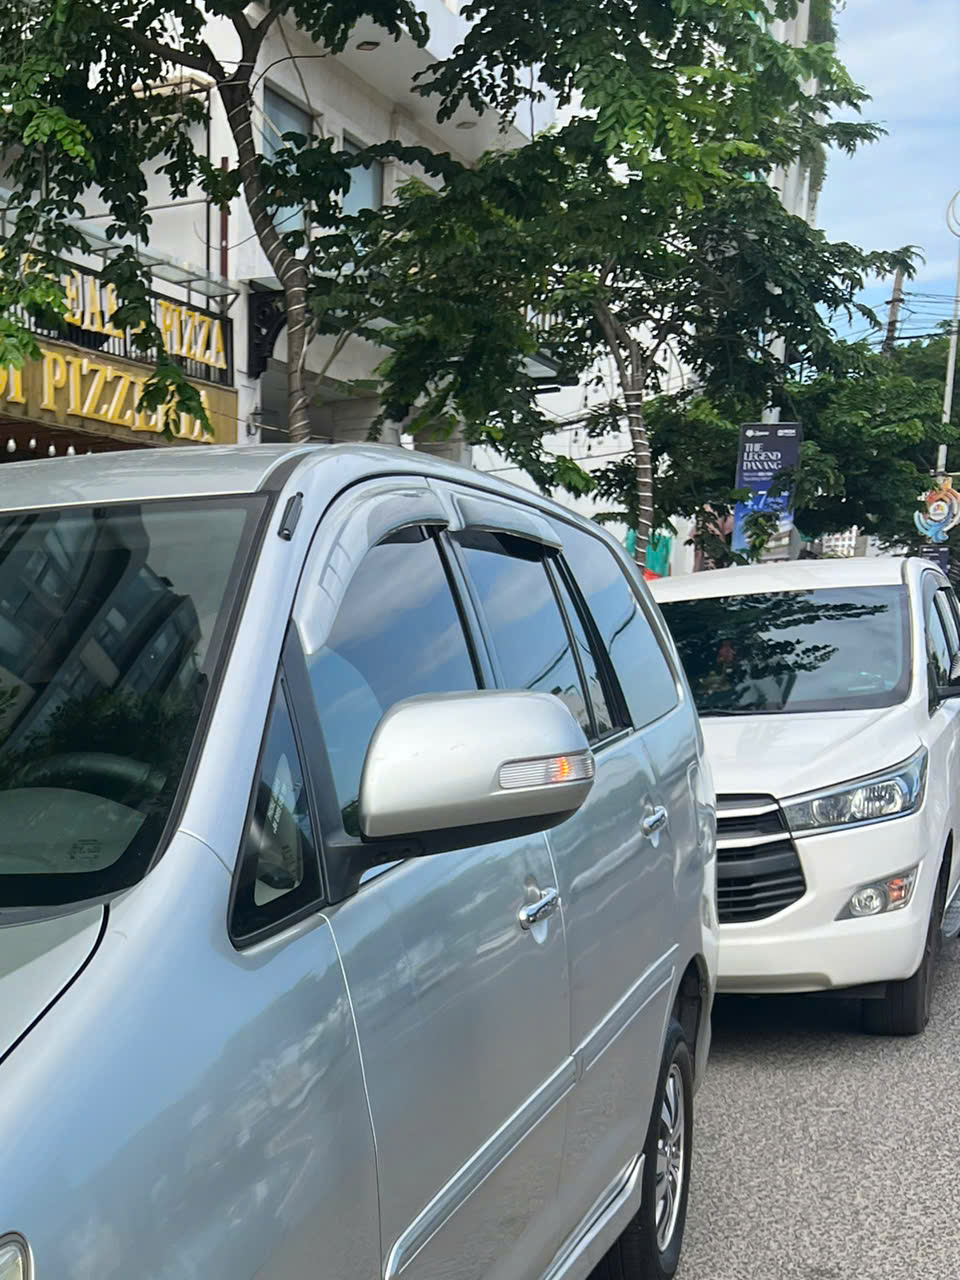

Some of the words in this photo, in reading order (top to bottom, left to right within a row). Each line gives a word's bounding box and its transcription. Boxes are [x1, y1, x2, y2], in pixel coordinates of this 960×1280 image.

[156, 299, 227, 370] PIZZA
[743, 443, 764, 453] THE
[743, 451, 782, 461] LEGEND
[742, 460, 783, 471] DANANG
